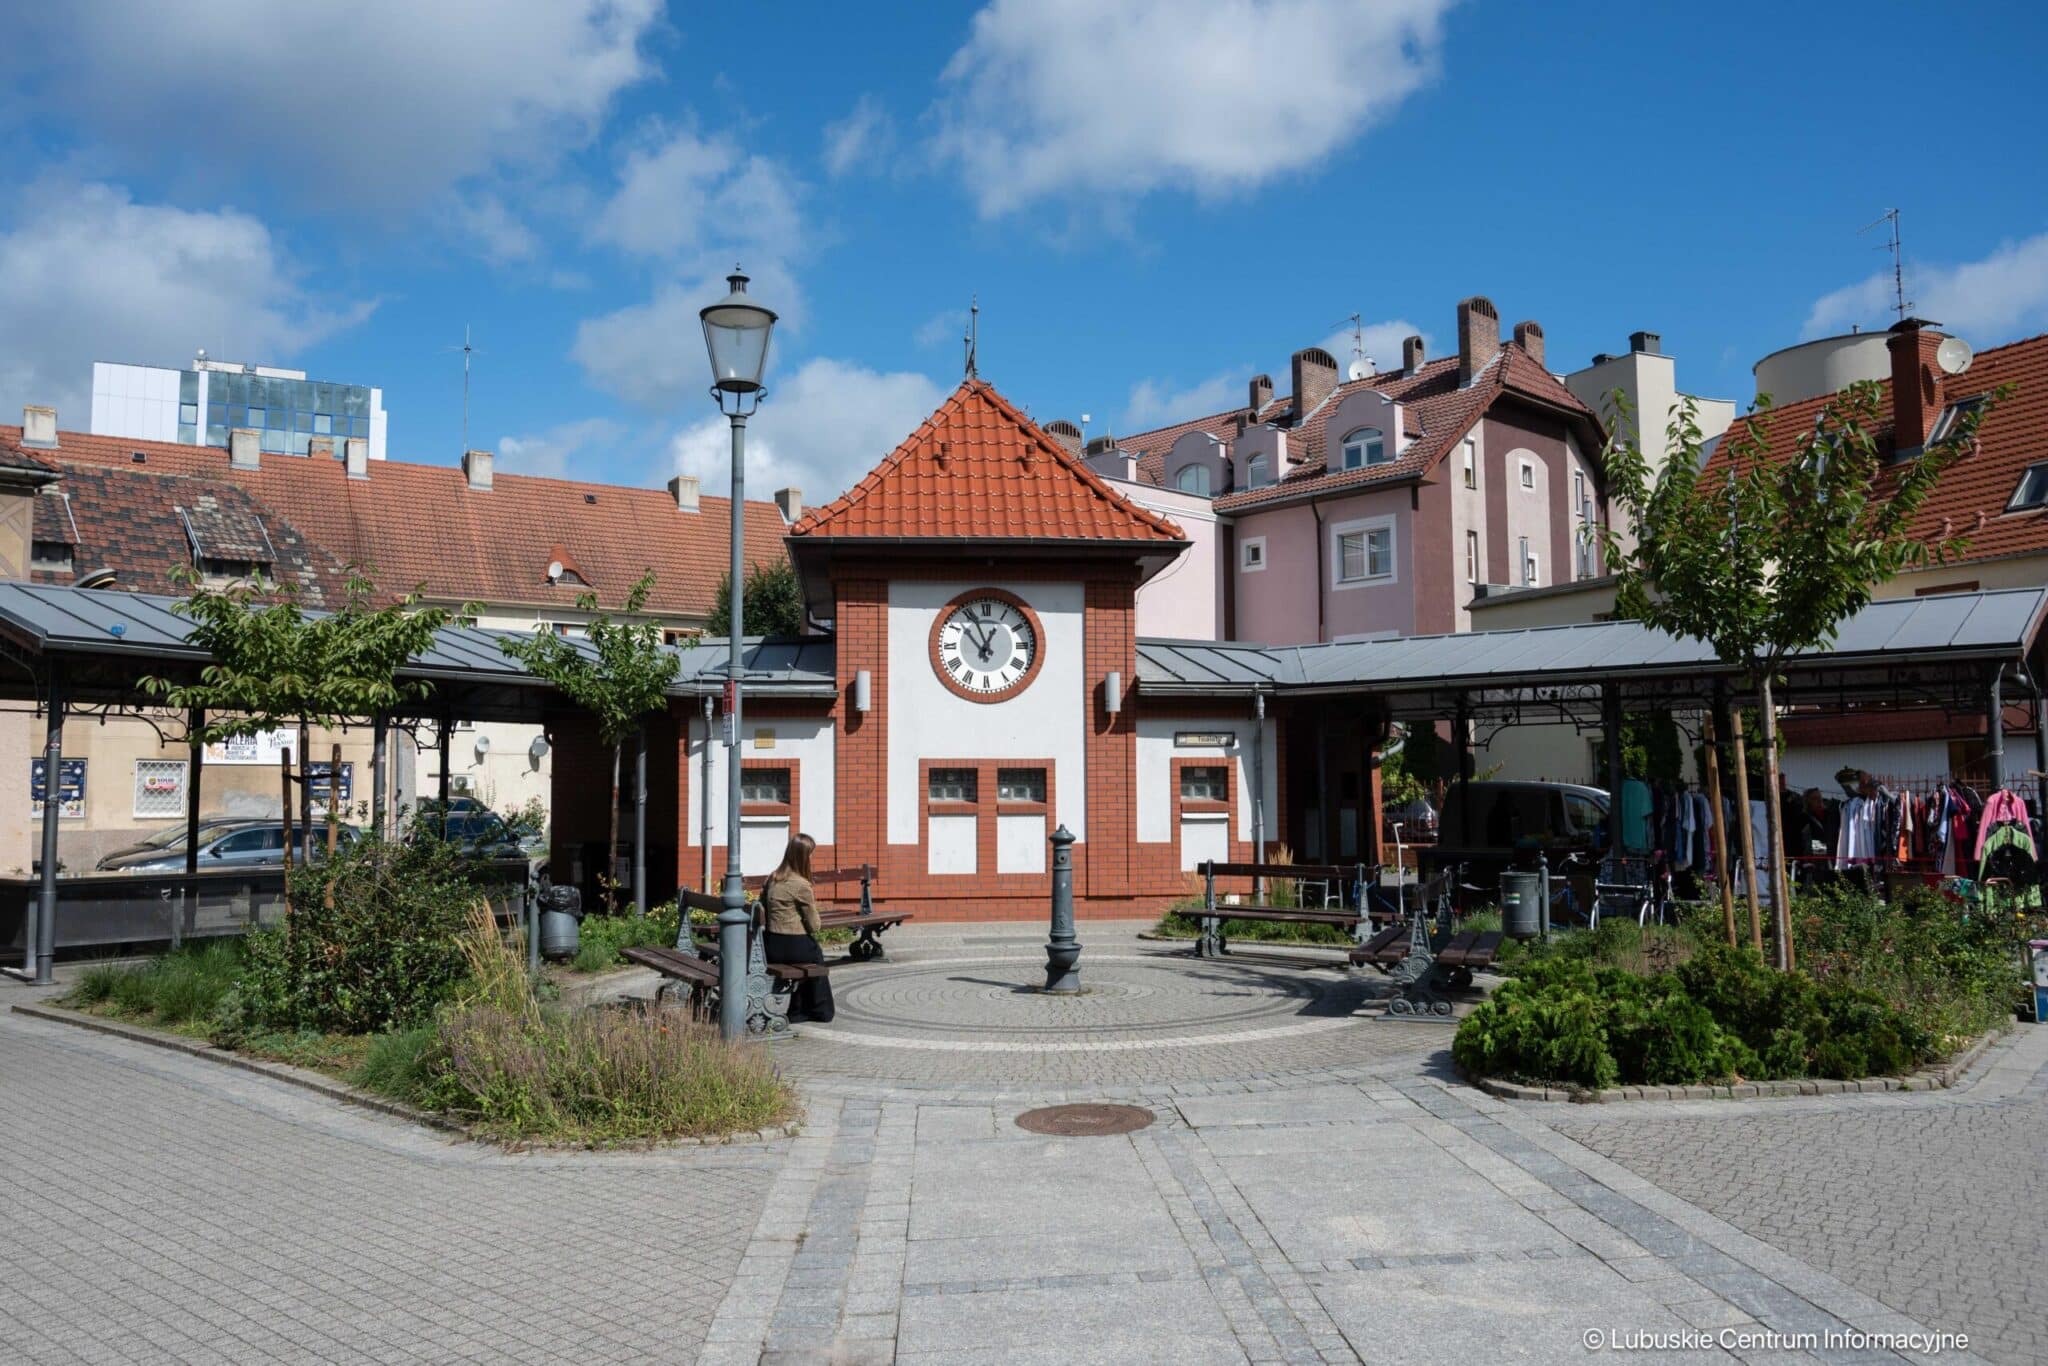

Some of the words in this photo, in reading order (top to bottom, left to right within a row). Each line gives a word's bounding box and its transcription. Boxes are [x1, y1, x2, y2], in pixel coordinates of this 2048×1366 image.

[980, 603, 992, 617] XII
[943, 642, 957, 650] IX
[1015, 641, 1029, 650] III
